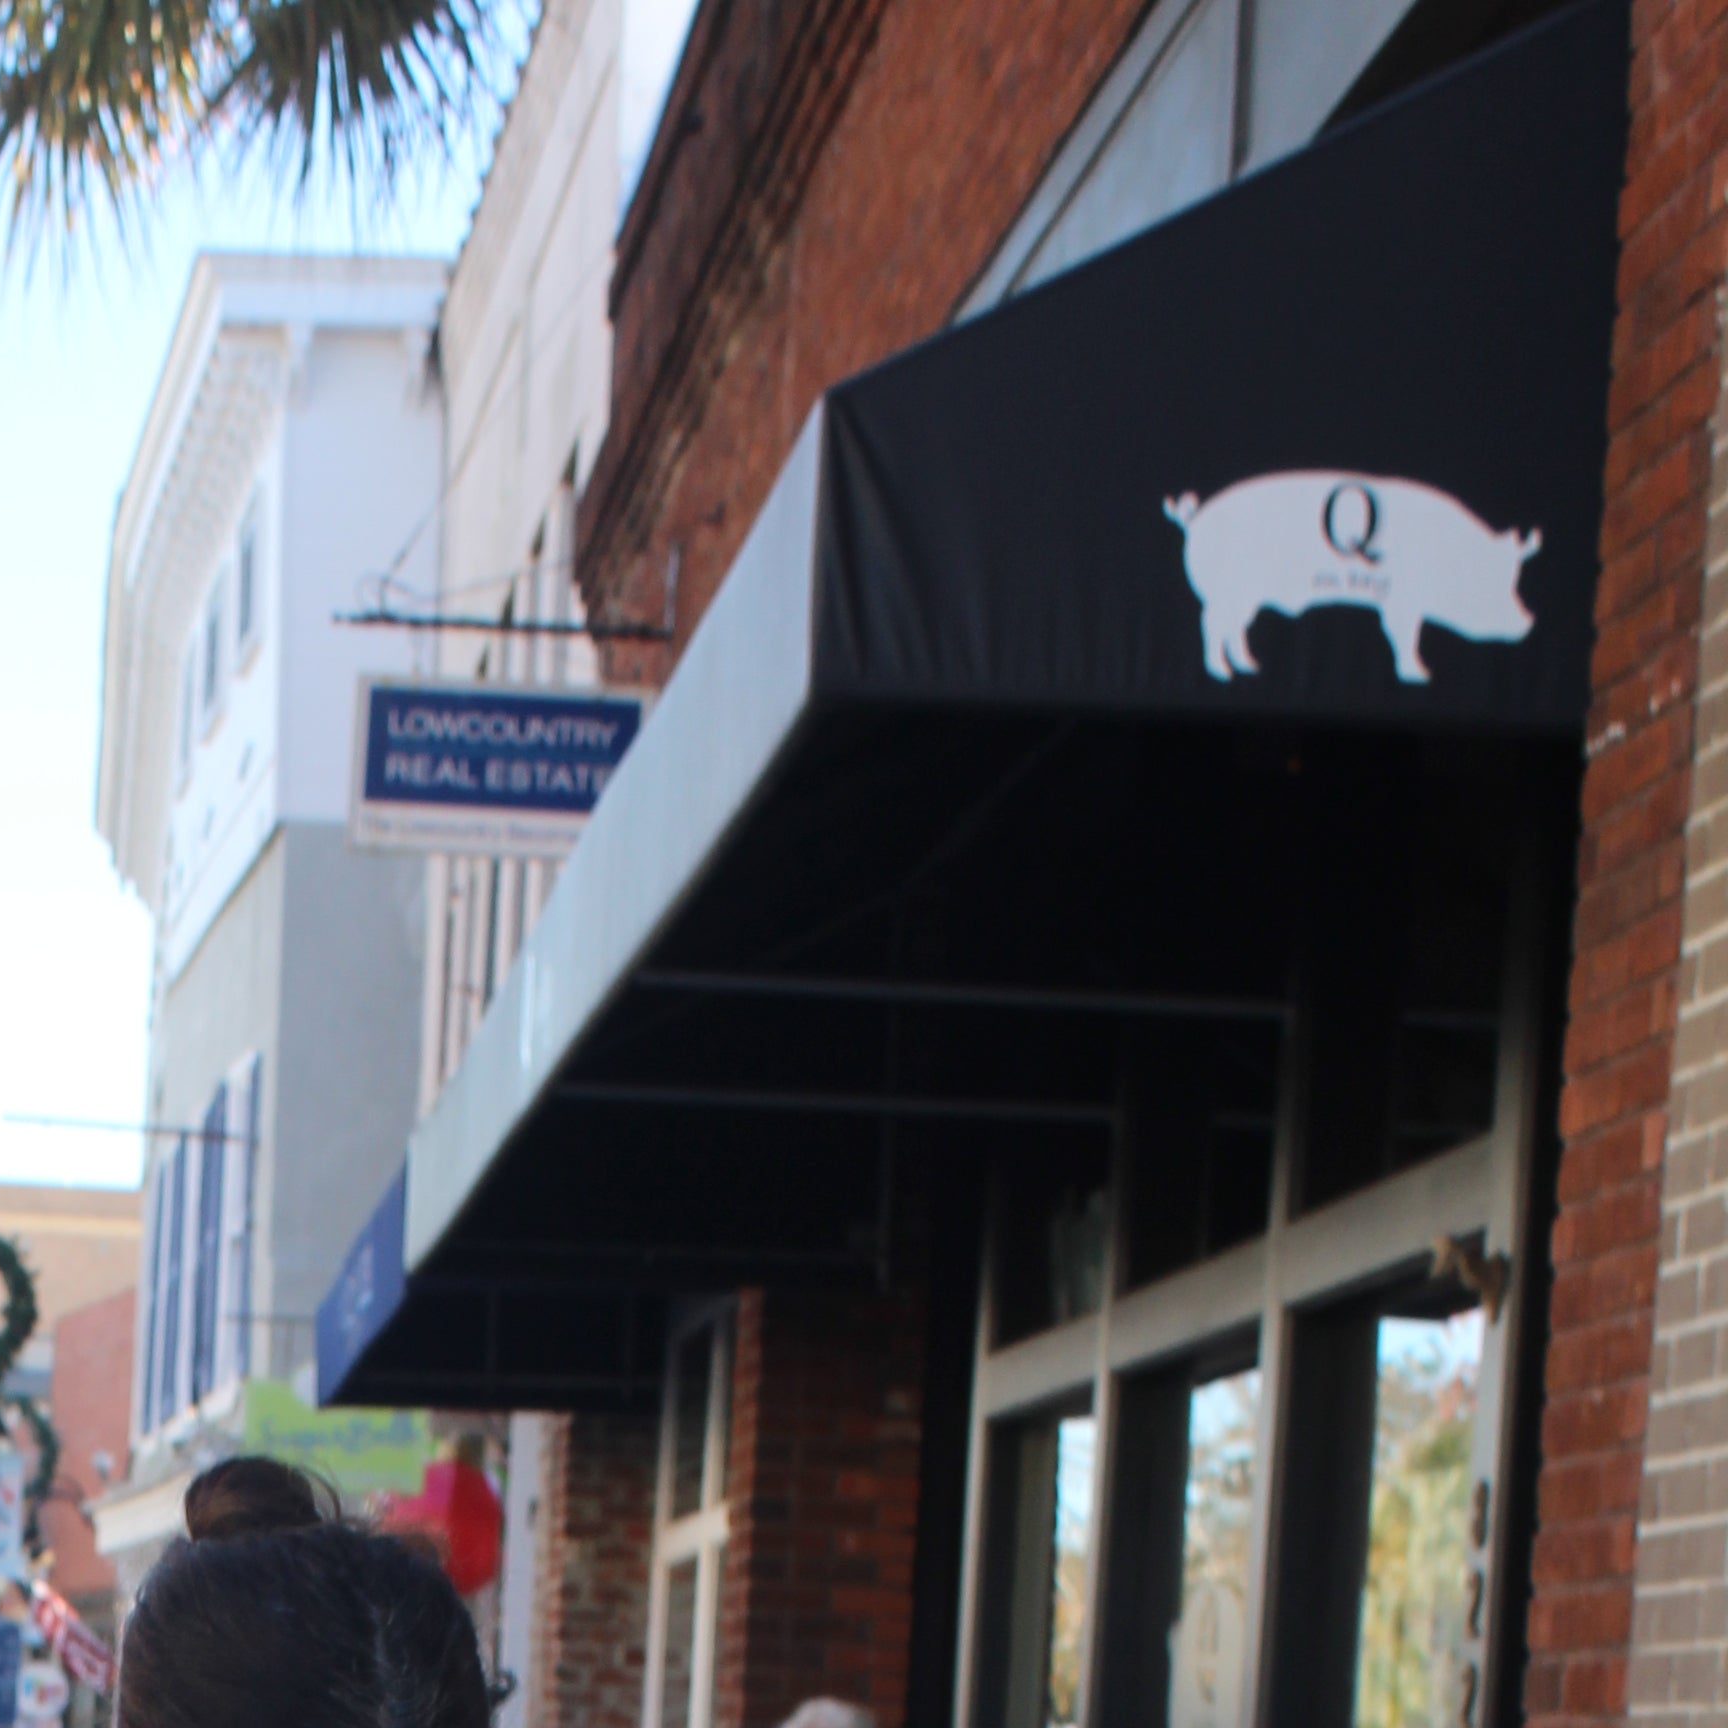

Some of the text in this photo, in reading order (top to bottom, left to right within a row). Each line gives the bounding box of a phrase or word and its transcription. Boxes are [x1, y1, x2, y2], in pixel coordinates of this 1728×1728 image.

[1322, 479, 1384, 565] Q
[386, 707, 619, 748] LOWCOUNTRY
[383, 752, 615, 794] REAL ESTATE
